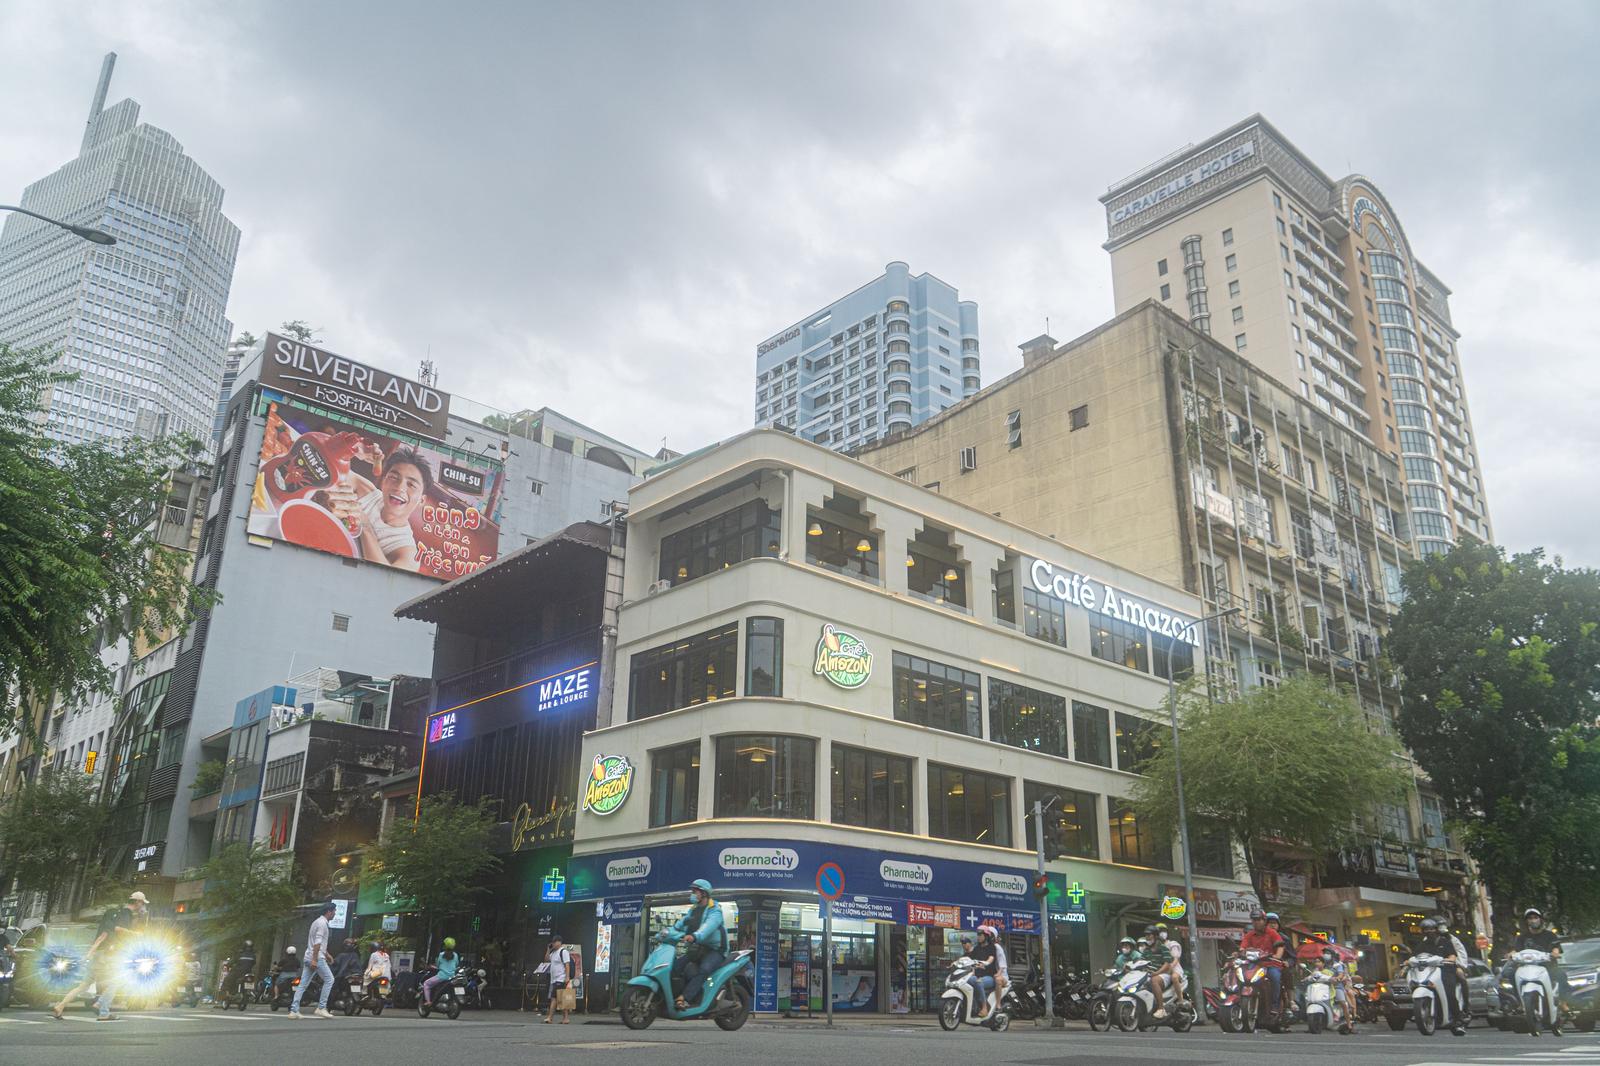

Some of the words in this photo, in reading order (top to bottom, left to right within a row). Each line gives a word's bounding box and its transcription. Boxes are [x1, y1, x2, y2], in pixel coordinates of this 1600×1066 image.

[1113, 174, 1194, 222] CARAVELLE
[1201, 146, 1251, 178] HOTEL
[275, 340, 442, 413] SILVERLAND
[302, 443, 329, 479] CHIN-SU
[443, 468, 481, 487] CHIN-SU
[1031, 559, 1096, 609] Café
[1101, 585, 1200, 647] Amazon
[540, 670, 590, 702] MAZE
[538, 701, 552, 712] BAR
[560, 690, 589, 705] LOUNGE
[443, 713, 456, 727] MA
[441, 725, 455, 740] ZE
[608, 860, 648, 877] Pharmacity
[724, 851, 794, 869] Pharmacity
[883, 865, 929, 883] Pharmacity
[984, 877, 1024, 893] Pharmacity
[916, 909, 927, 920] 70
[934, 912, 945, 923] 40
